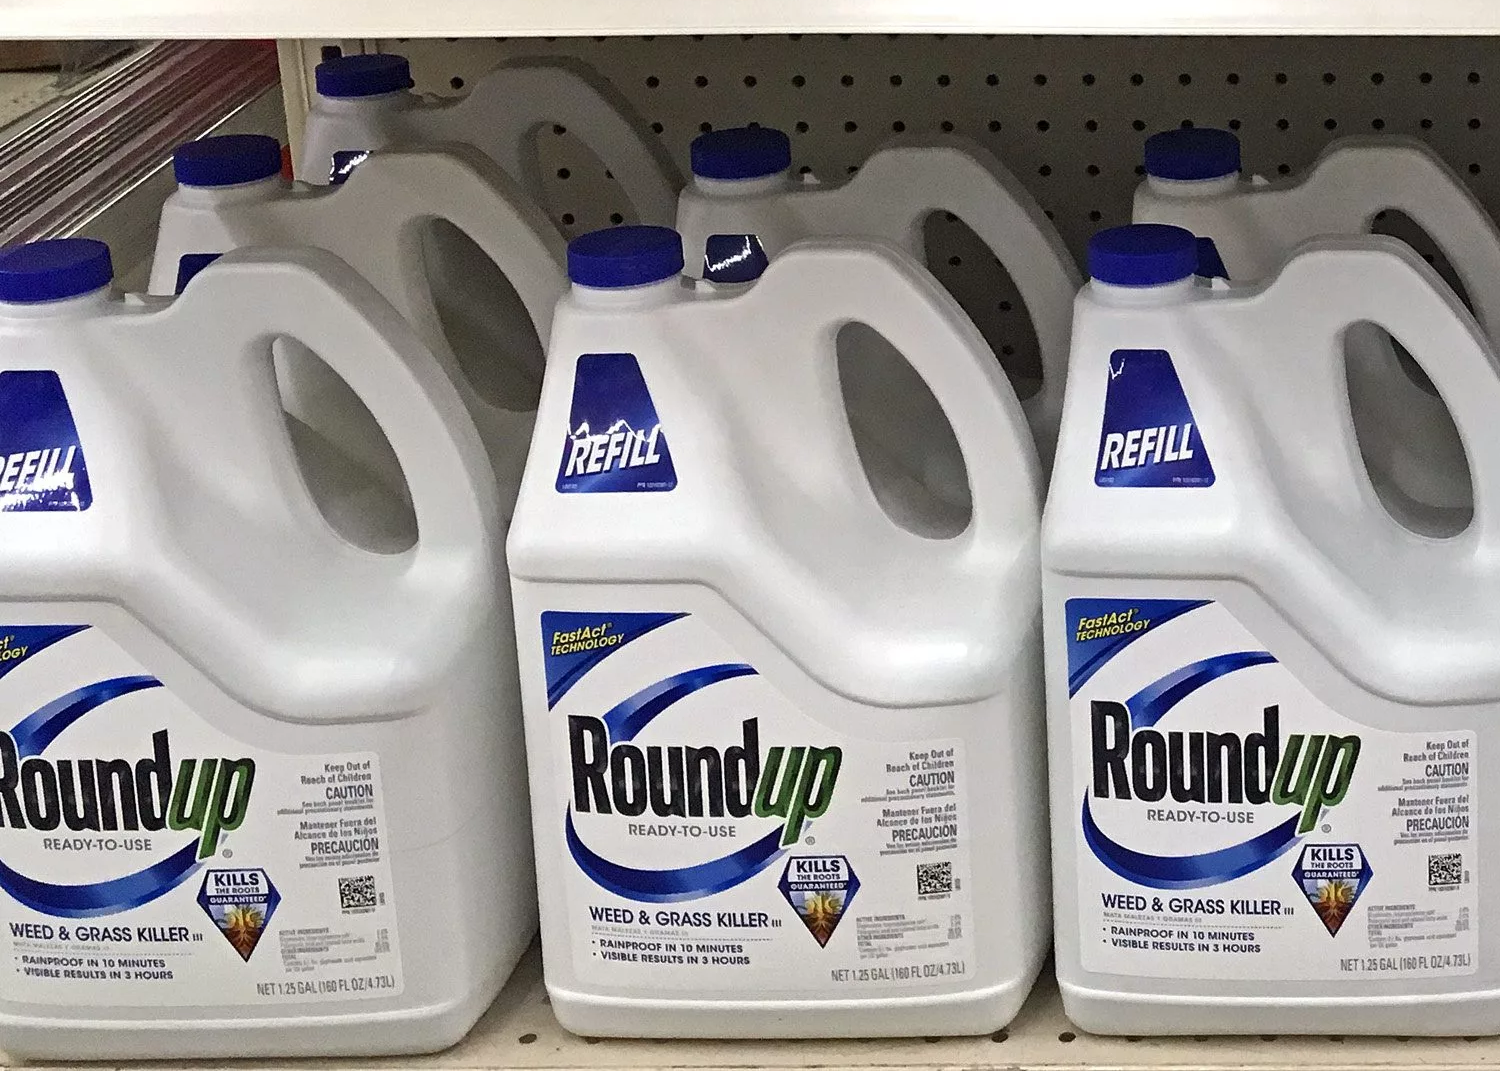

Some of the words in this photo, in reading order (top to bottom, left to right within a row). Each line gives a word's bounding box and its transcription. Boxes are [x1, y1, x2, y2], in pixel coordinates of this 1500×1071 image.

[566, 428, 662, 476] REFILL
[1101, 424, 1195, 470] REFILL
[1080, 610, 1133, 630] FastAct
[554, 625, 608, 644] FastAct
[1077, 621, 1150, 640] TECHNOLOGY
[552, 635, 623, 655] TECHNOLOGY
[1091, 699, 1360, 835] Roundup
[1426, 763, 1469, 779] CAUTION
[568, 715, 843, 850] Roundup
[910, 772, 954, 788] CAUTION
[326, 784, 373, 801] CAUTION
[1147, 809, 1253, 823] READY-TO-USE
[629, 824, 735, 837] READY-TO-USE
[44, 838, 151, 851] READY-TO-USE
[1311, 847, 1354, 862] KILLS
[796, 859, 841, 874] KILLS
[214, 872, 259, 887] KILLS
[1102, 893, 1146, 910] WEED
[1152, 897, 1163, 912] &
[1169, 898, 1224, 914] GRASS
[1231, 900, 1281, 915] KILLER
[589, 906, 633, 923] WEED
[639, 910, 650, 925] &
[656, 911, 711, 927] GRASS
[717, 913, 768, 927] KILLER
[9, 923, 53, 939] WEED
[59, 926, 70, 940] &
[76, 927, 132, 941] GRASS
[137, 927, 189, 942] KILLER
